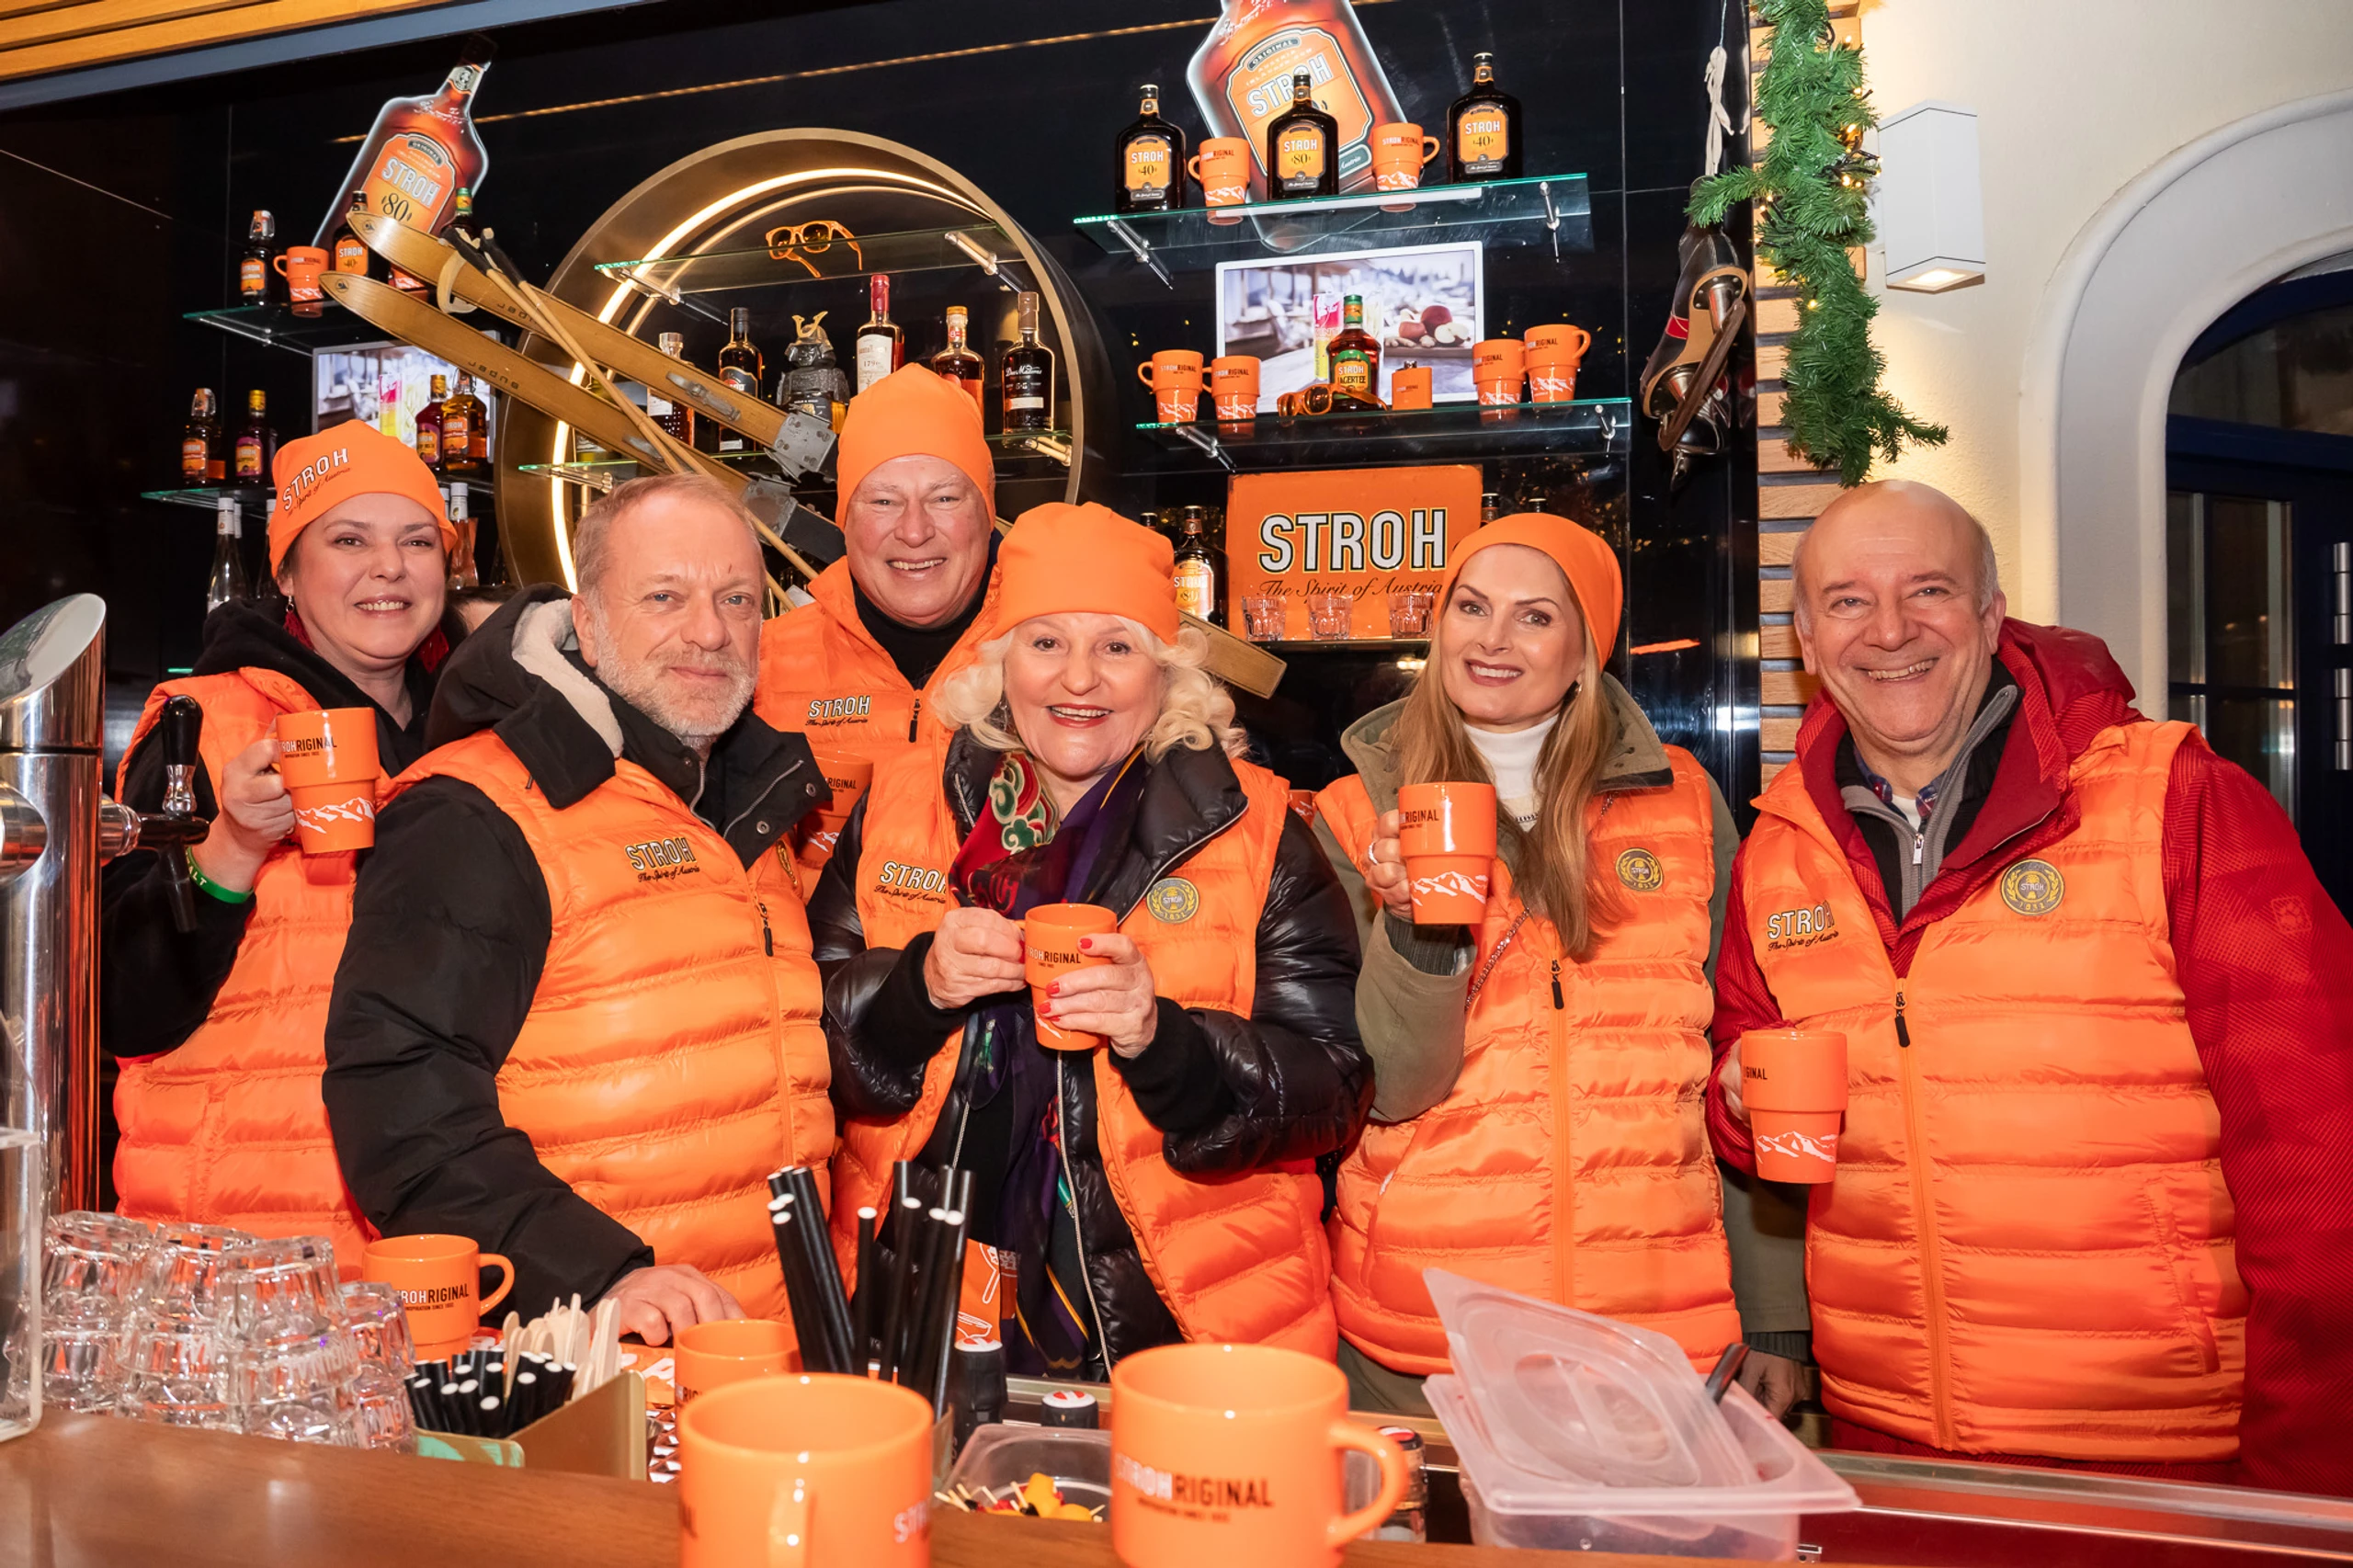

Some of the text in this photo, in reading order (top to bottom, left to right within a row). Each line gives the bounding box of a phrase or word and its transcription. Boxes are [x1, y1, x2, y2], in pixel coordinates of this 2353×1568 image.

[1464, 120, 1501, 134] STROH
[1284, 139, 1318, 153] STROH
[1473, 135, 1494, 147] 40
[1131, 151, 1164, 164] STROH
[1290, 153, 1312, 165] 80
[1138, 165, 1157, 176] 40
[381, 157, 441, 207] STROH
[339, 246, 363, 257] STROH
[1338, 365, 1364, 375] STROH
[282, 448, 348, 511] STROH
[1258, 507, 1448, 573] STROH
[1257, 579, 1293, 597] The
[1296, 578, 1351, 604] Spirit
[1352, 577, 1381, 601] of
[1372, 576, 1443, 596] Austria
[808, 695, 871, 719] STROH
[824, 777, 857, 790] RIGINAL
[625, 837, 697, 871] STROH
[1768, 900, 1835, 939] STROH
[397, 1283, 470, 1304] ROHRIGINAL
